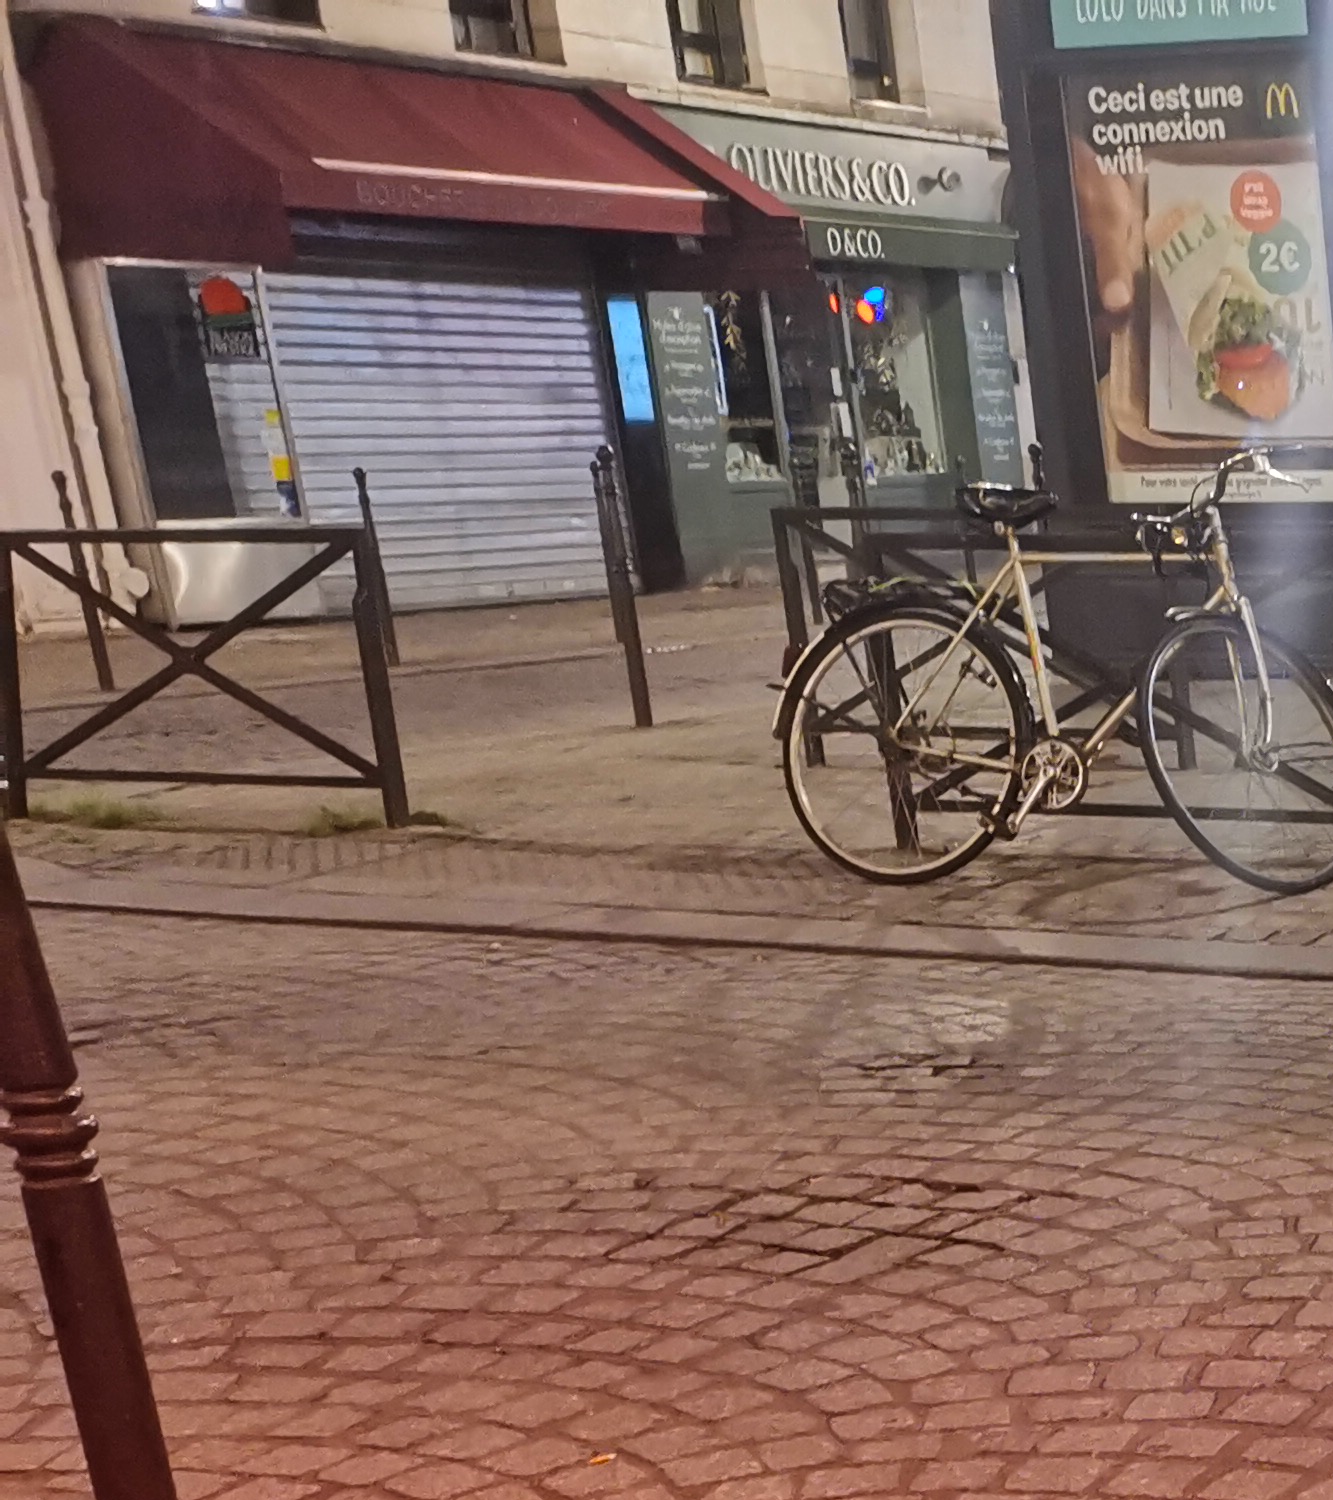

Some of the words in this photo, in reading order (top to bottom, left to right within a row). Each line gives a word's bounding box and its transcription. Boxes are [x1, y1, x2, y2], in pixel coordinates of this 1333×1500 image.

[1087, 82, 1146, 114] Ceci
[1150, 83, 1191, 111] est
[1194, 84, 1244, 109] une
[1092, 111, 1226, 145] connexion
[1095, 145, 1149, 176] wifi.
[1259, 240, 1301, 274] 2€
